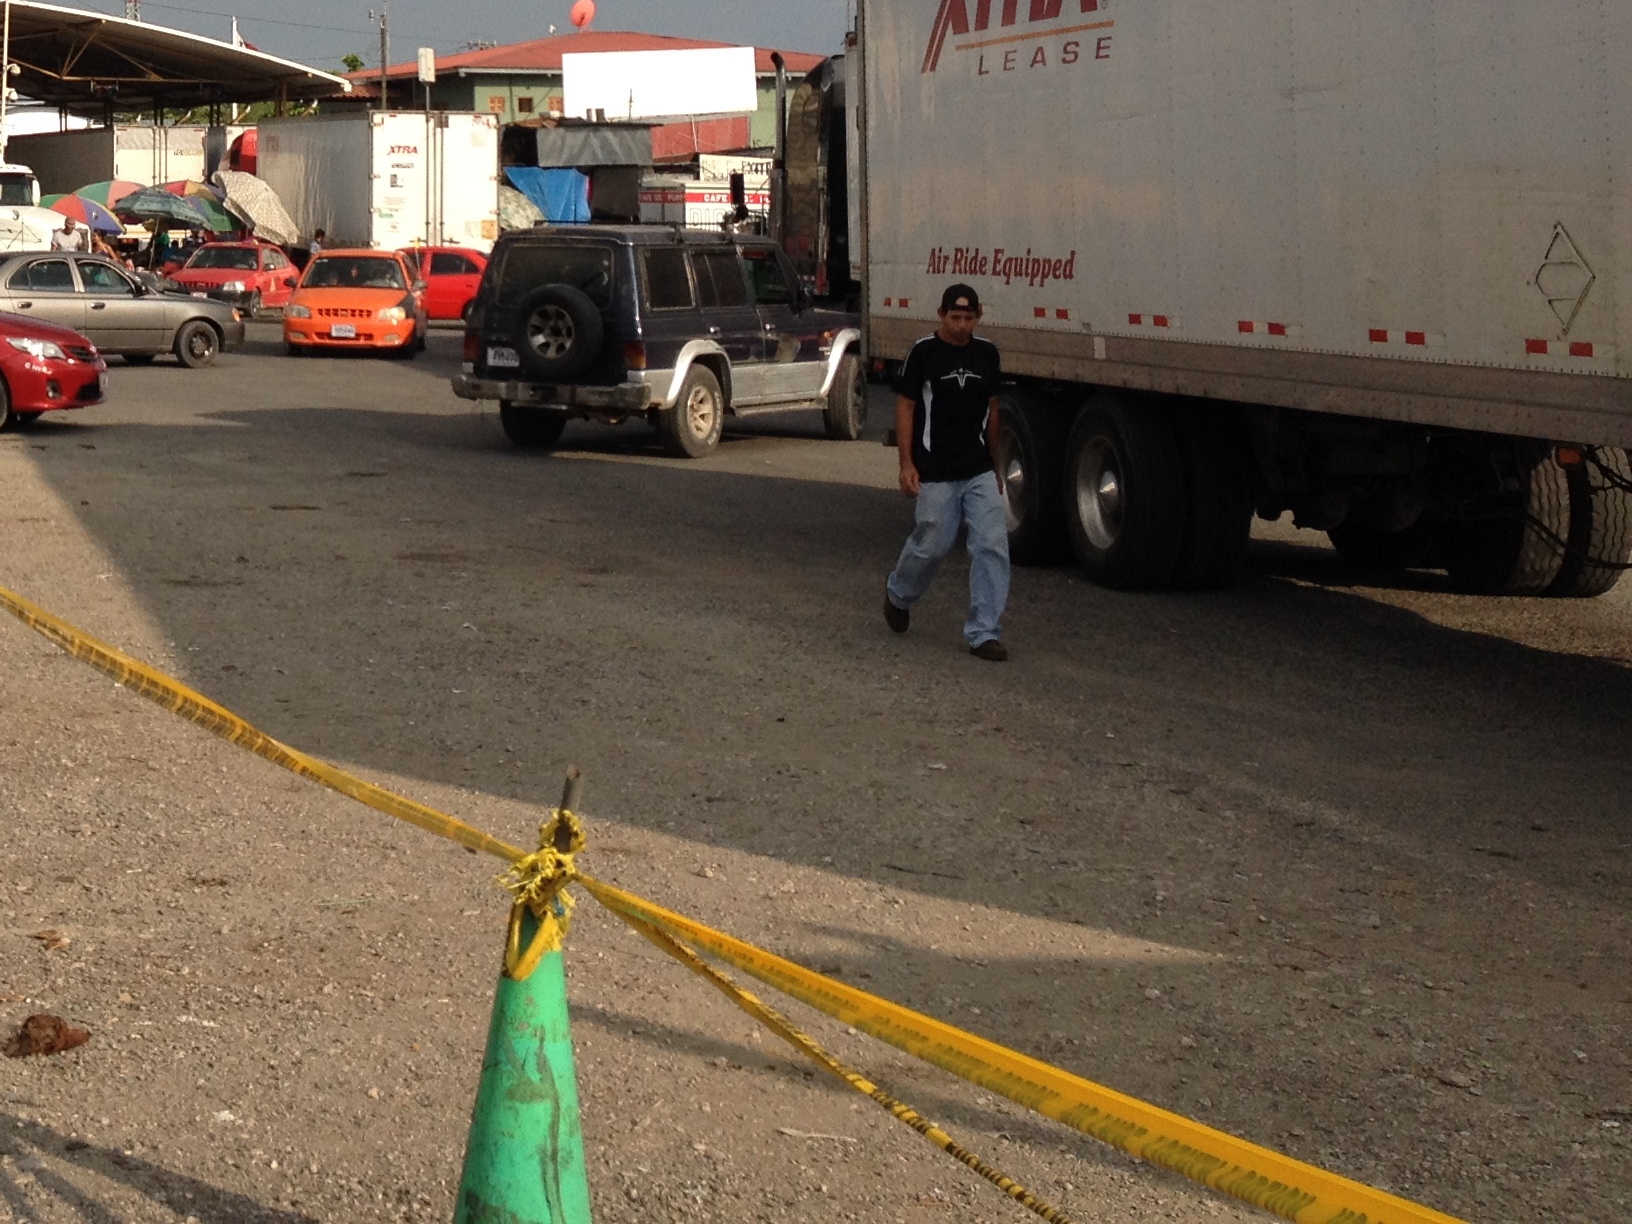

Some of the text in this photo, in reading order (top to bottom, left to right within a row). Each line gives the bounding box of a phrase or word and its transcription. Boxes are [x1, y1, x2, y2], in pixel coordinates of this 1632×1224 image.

[977, 36, 1113, 76] LEASE
[386, 145, 418, 156] XTRA
[926, 247, 1076, 287] Air Ride Equipped
